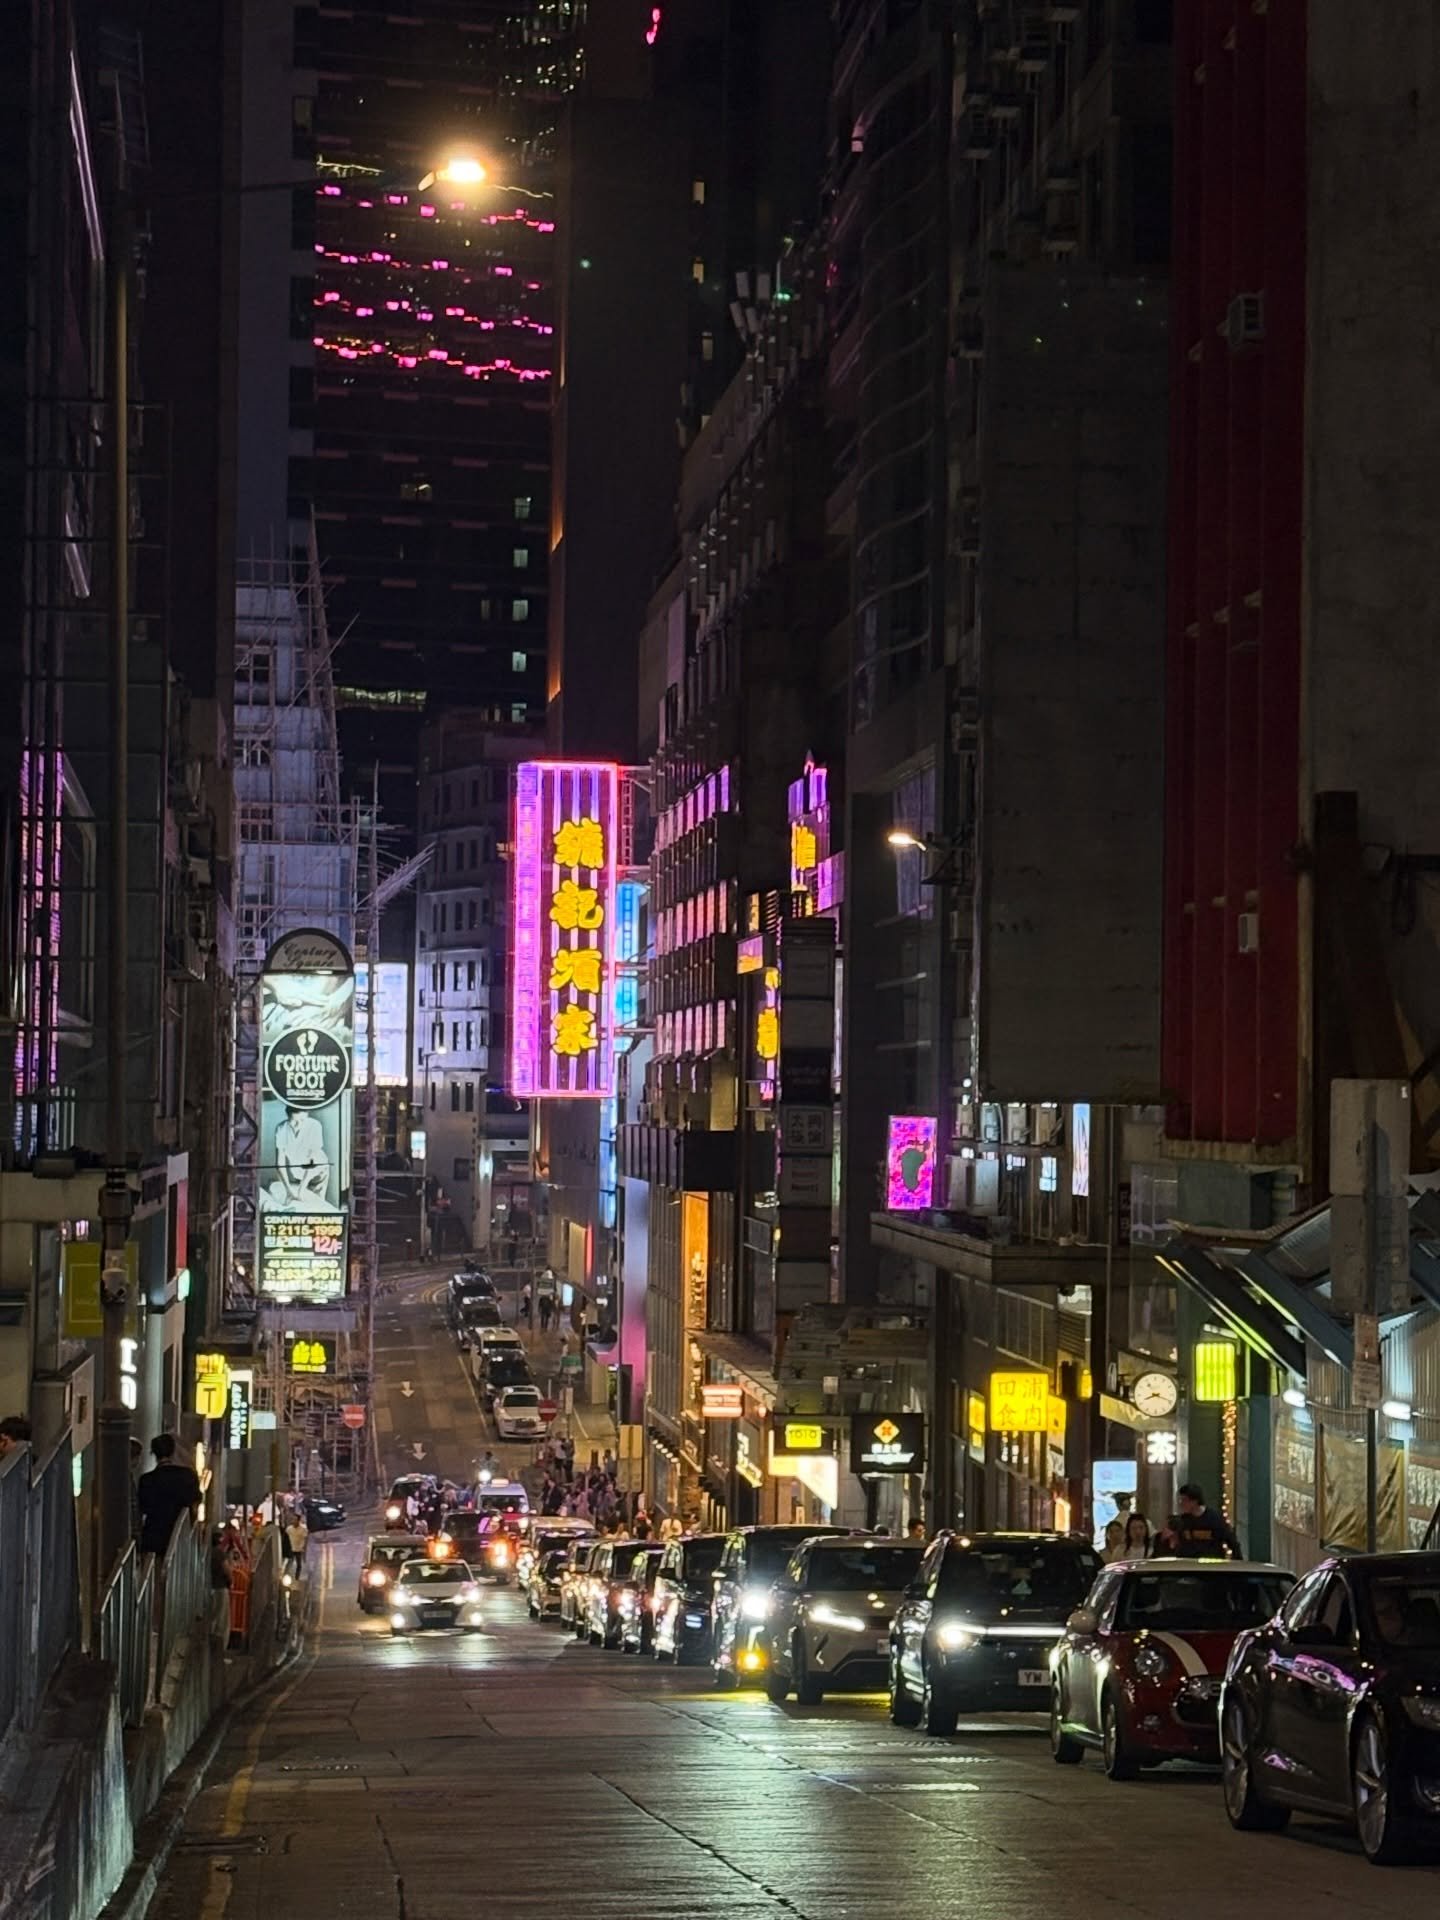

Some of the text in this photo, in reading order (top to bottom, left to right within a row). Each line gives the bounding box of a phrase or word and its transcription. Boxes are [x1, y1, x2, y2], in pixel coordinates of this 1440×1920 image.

[283, 943, 338, 959] Century
[275, 1054, 341, 1073] FORTUNE
[285, 1072, 327, 1089] FOOT
[264, 1216, 344, 1225] CENTURY SQUARE
[264, 1225, 277, 1236] T:
[313, 1236, 343, 1255] 12/F
[311, 1260, 338, 1269] ROAD
[263, 1268, 276, 1280] T:
[1147, 1430, 1177, 1465] 茶
